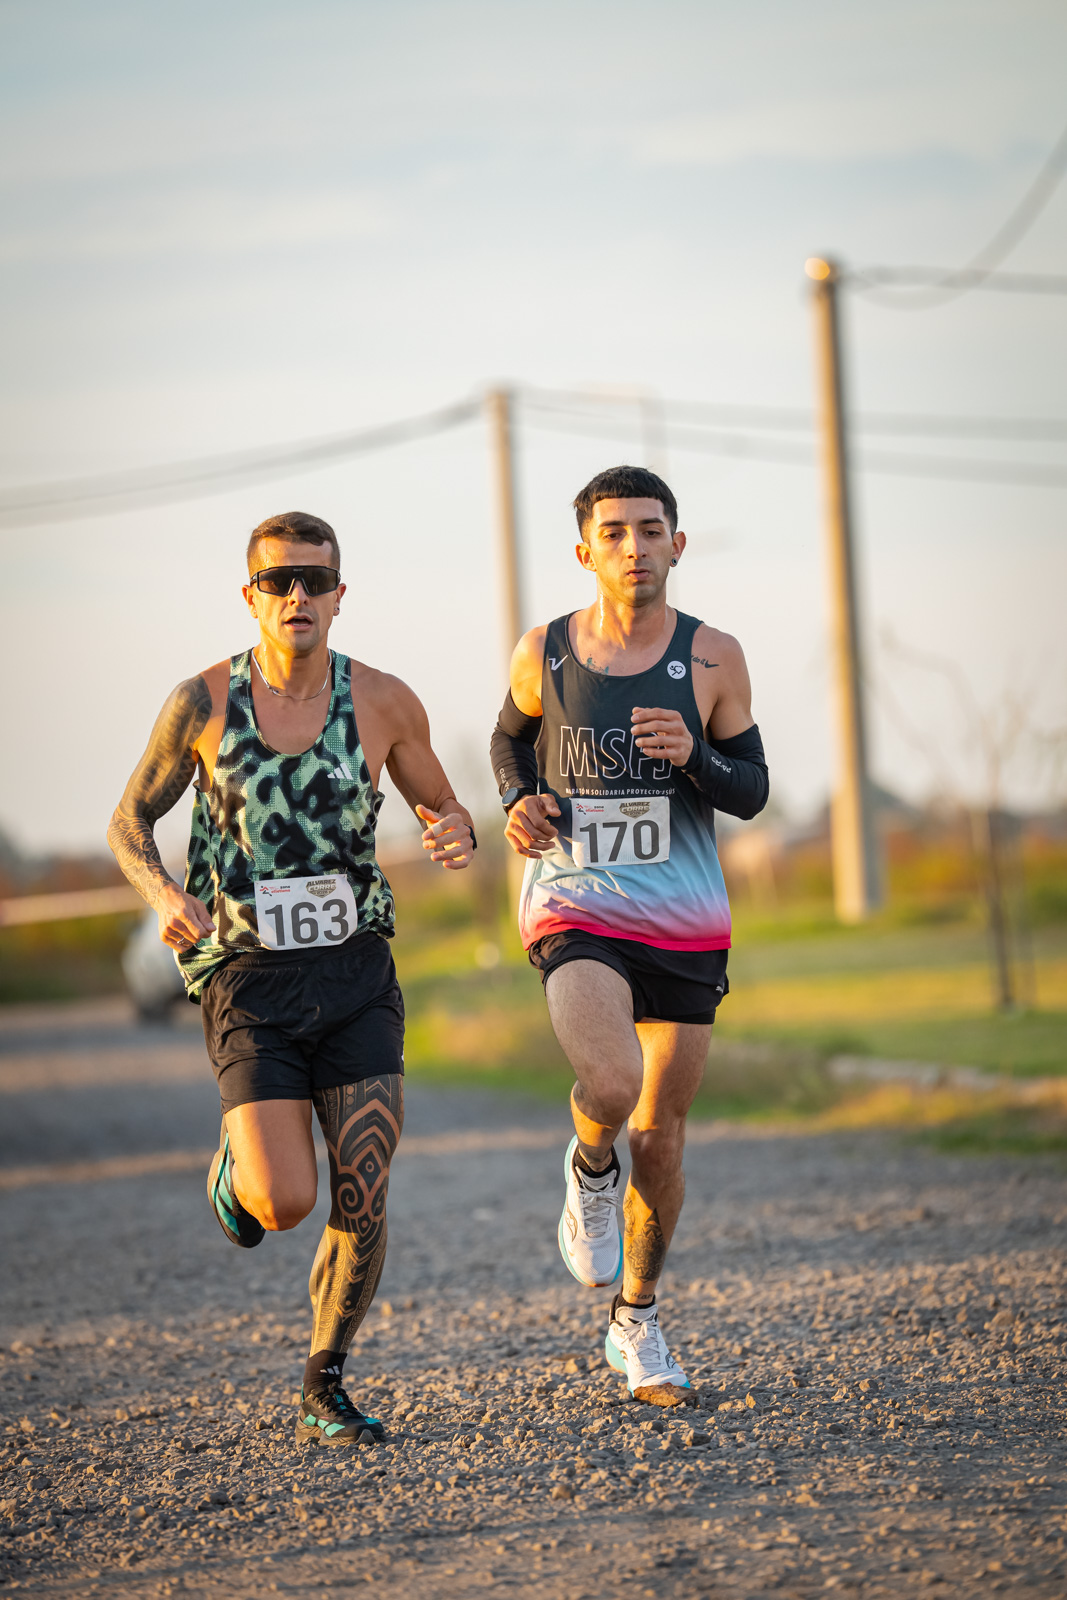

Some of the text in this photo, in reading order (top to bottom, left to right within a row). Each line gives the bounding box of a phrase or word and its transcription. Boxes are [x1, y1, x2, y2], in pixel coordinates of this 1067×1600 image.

[590, 788, 625, 796] SOLIDARIA
[626, 788, 661, 796] PROYECTO
[660, 787, 676, 796] JSÚS
[580, 820, 660, 863] 170
[306, 878, 337, 886] ALVAREZ
[308, 883, 337, 892] CORRE
[265, 899, 349, 946] 163
